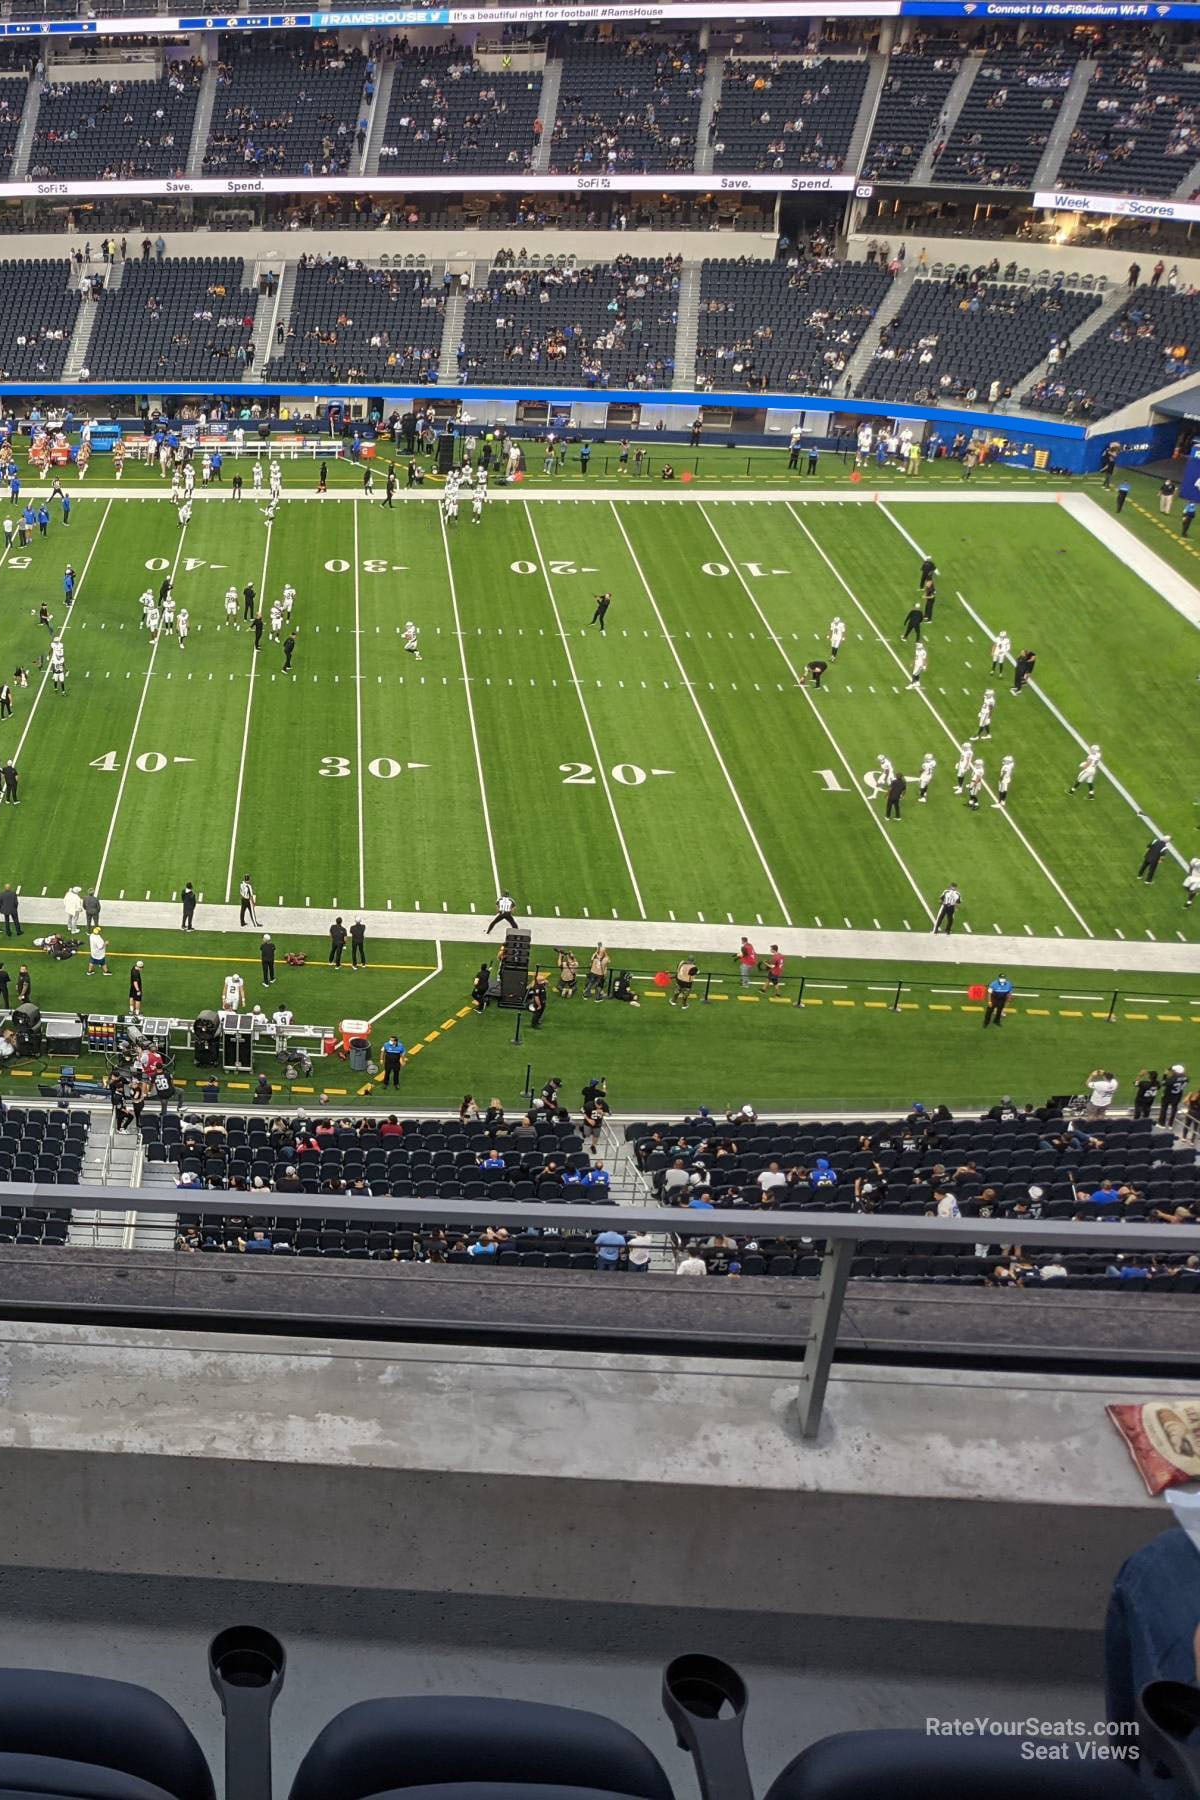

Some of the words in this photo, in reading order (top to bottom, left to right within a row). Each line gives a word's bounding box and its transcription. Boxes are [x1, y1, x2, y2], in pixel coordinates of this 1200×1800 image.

[453, 12, 467, 21] It's
[477, 11, 518, 20] beautiful
[519, 10, 542, 20] night
[543, 10, 557, 19] for
[560, 9, 599, 18] football!
[600, 8, 663, 17] #RamsHouse
[987, 4, 1030, 14] Connect
[1031, 5, 1042, 14] to
[1044, 4, 1117, 15] #SoFiStadium
[1119, 5, 1148, 16] Wi-Fi
[320, 12, 427, 25] #RAMSHOUSE
[38, 184, 58, 194] SoFi
[166, 182, 193, 192] Save.
[227, 181, 264, 192] Spend.
[577, 178, 599, 188] SoFi
[721, 178, 751, 189] Save.
[791, 178, 833, 190] Spend.
[1055, 195, 1090, 209] Week
[1128, 201, 1174, 216] Scores
[89, 750, 168, 772] 40
[318, 755, 402, 779] 30
[559, 762, 647, 786] 20
[709, 1258, 728, 1271] 75
